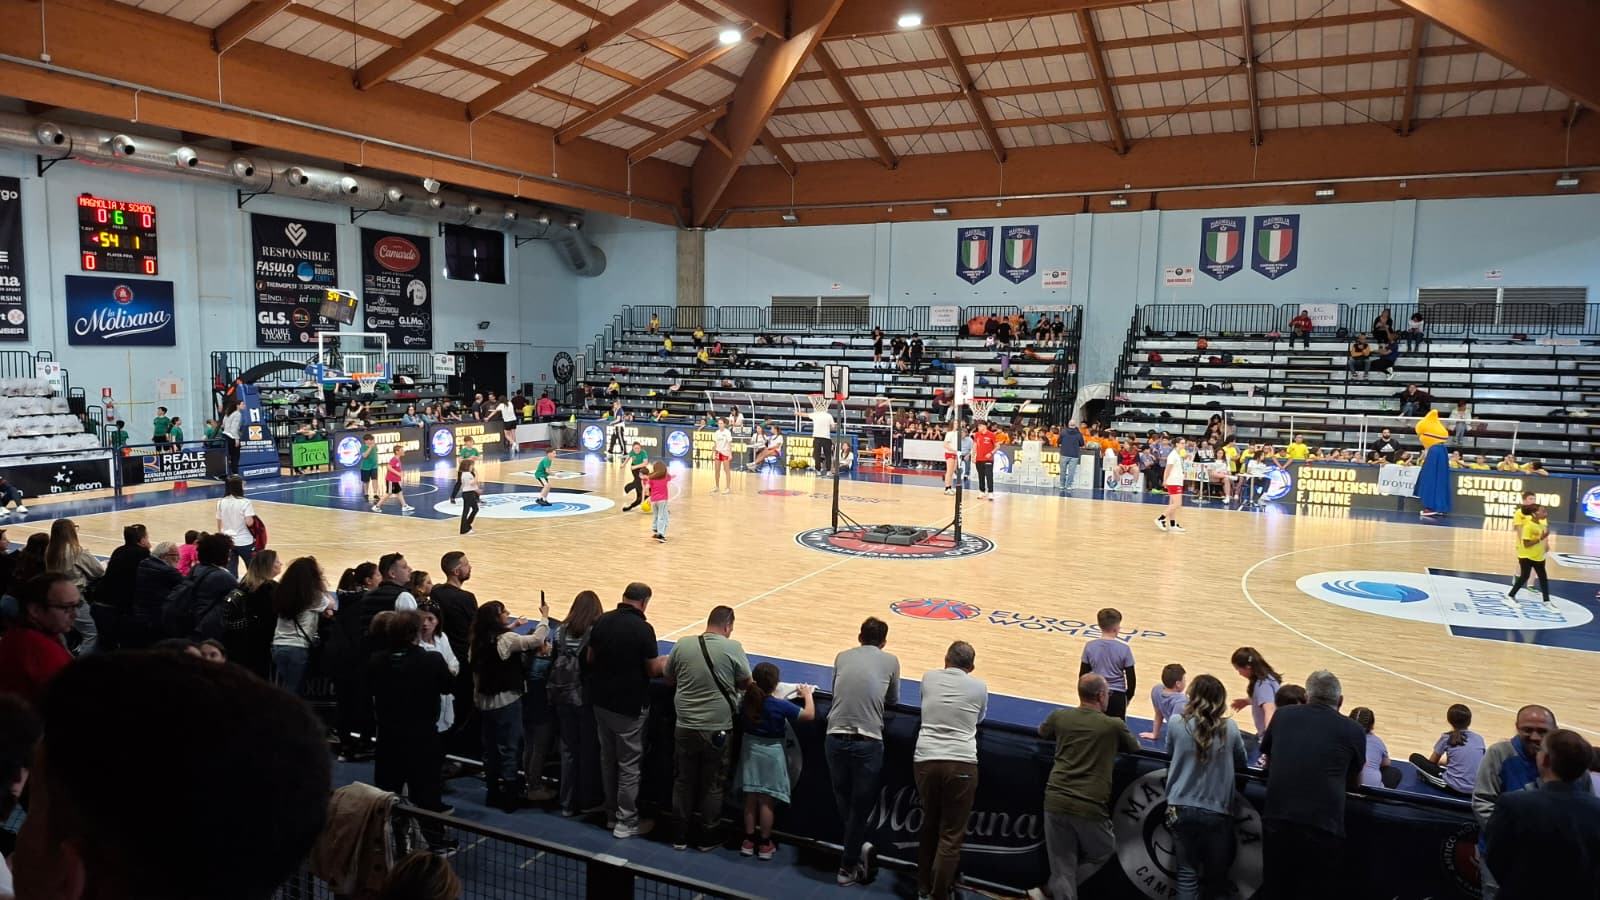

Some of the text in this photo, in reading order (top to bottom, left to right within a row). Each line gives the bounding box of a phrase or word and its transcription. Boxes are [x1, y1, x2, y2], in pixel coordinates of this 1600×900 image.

[79, 197, 155, 215] MAGNOLIA X SCHOOL
[97, 208, 107, 223] 0
[115, 210, 124, 225] 6
[142, 213, 152, 228] 0
[261, 246, 331, 262] RESPONSIBLE
[379, 244, 416, 260] Camardo
[85, 255, 96, 270] 0
[145, 260, 155, 275] 0
[256, 261, 295, 273] FASULO
[0, 275, 21, 287] na
[376, 276, 400, 285] REALE
[75, 307, 169, 337] Molisana
[258, 311, 290, 325] GLS.
[261, 327, 290, 336] EMPIRE
[264, 332, 292, 341] TRAVEL
[693, 431, 716, 442] ISTITU
[786, 436, 815, 447] ISTITU
[163, 452, 206, 464] REALE
[163, 461, 207, 472] MUTUA
[1298, 466, 1357, 482] ISTITUTO
[1382, 479, 1415, 489] D'OVID
[1458, 475, 1522, 492] ISTITUTO
[1296, 490, 1351, 506] F. JOVINE
[1484, 503, 1517, 517] VINE
[865, 784, 1042, 840] Moana
